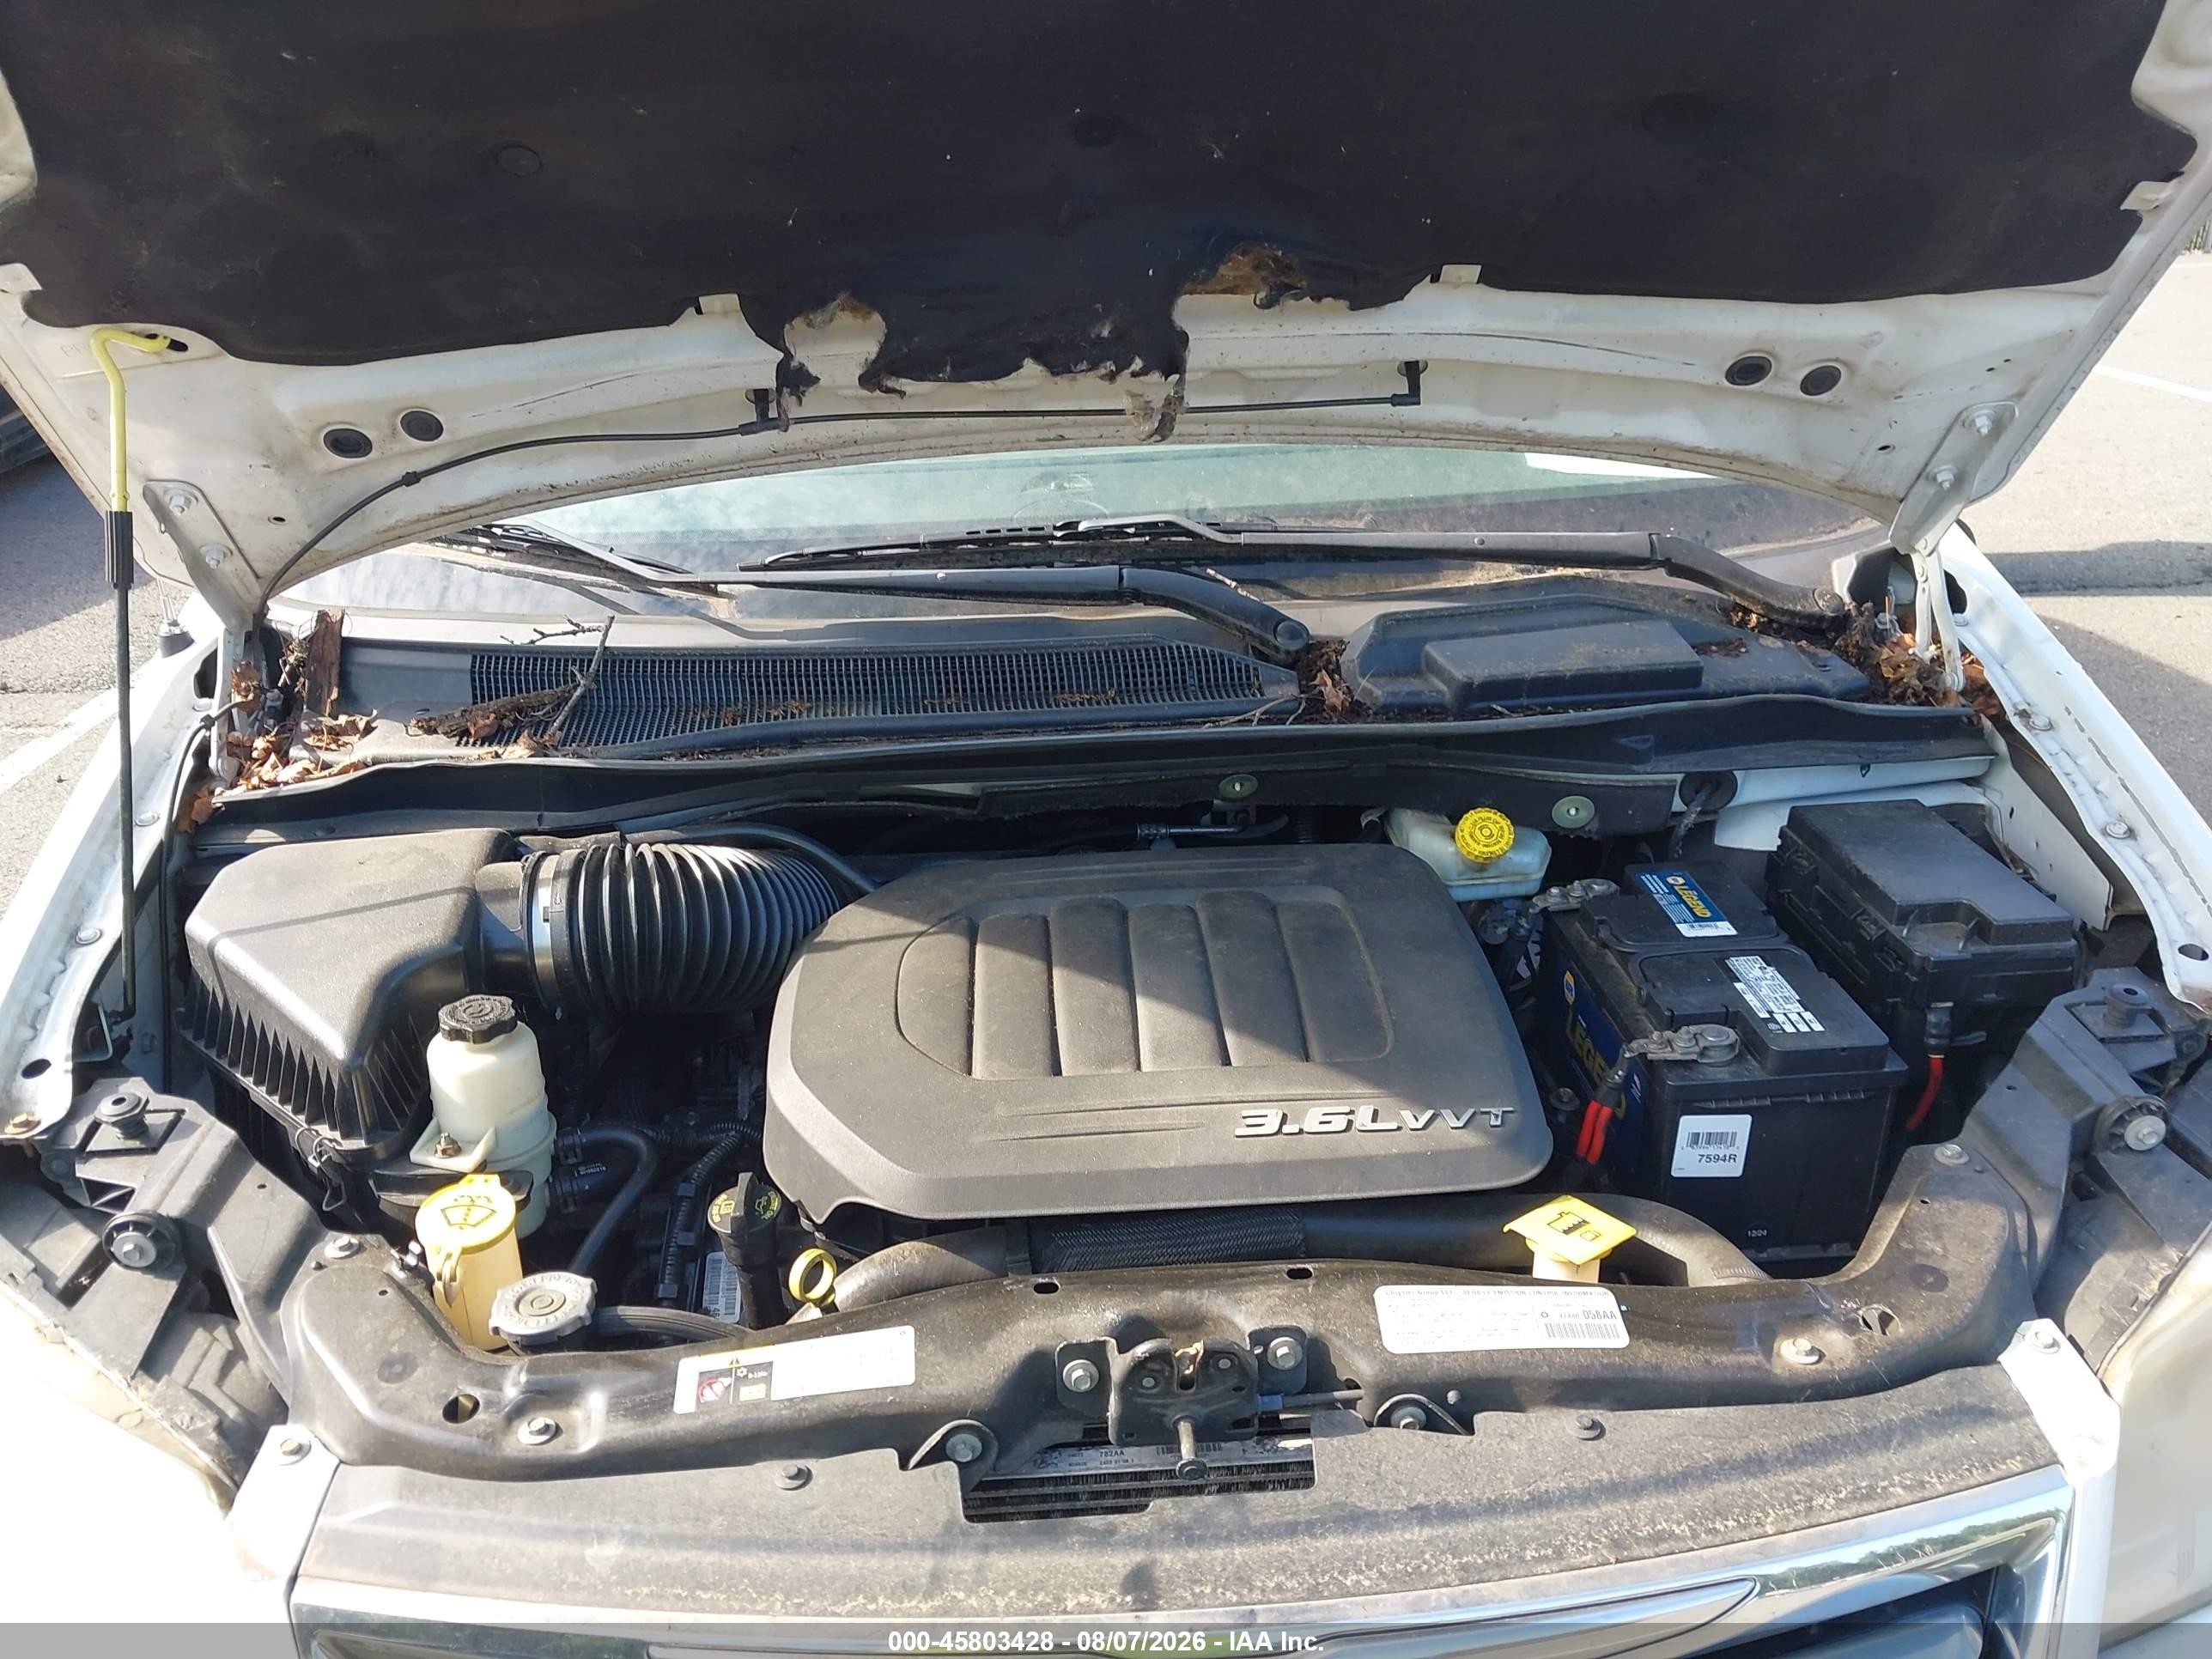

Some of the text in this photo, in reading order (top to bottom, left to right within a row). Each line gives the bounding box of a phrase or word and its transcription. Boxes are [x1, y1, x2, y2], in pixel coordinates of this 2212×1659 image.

[1234, 1104, 1515, 1138] 3.6L VVT
[1697, 1153, 1738, 1164] 7594R
